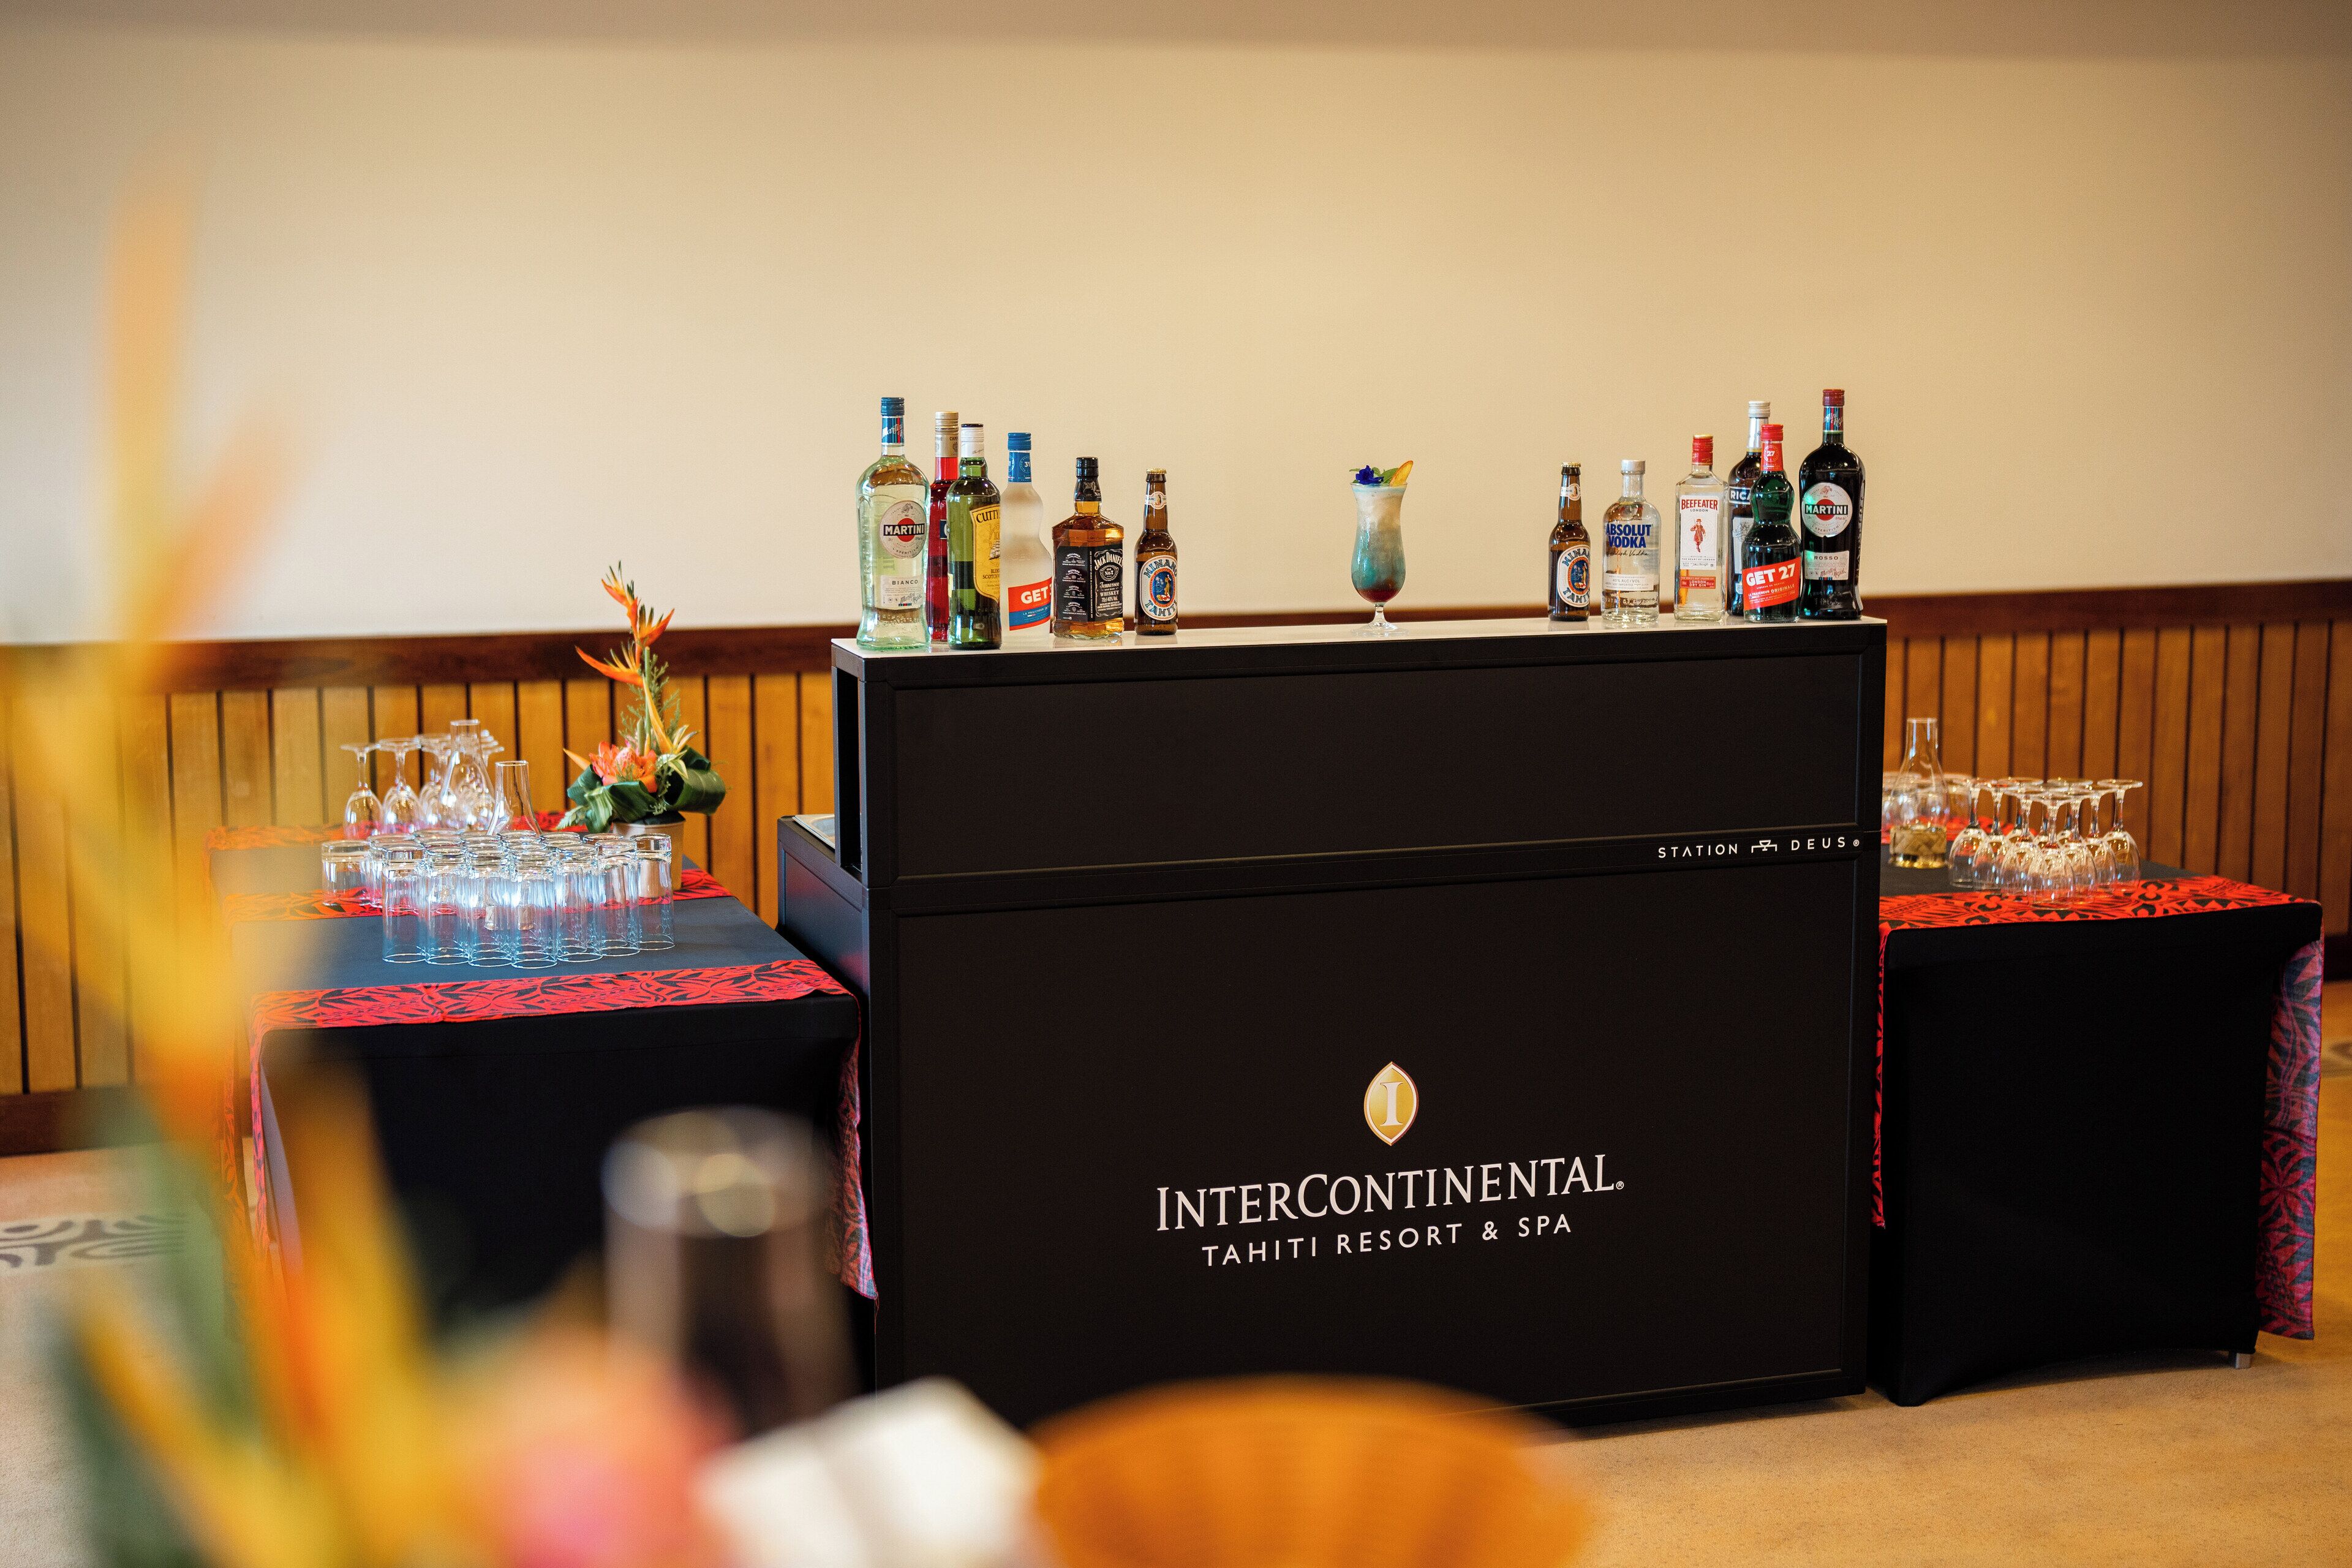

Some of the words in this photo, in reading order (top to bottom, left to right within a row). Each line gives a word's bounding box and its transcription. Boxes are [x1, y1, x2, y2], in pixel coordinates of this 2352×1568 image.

[1681, 499, 1718, 511] BEEFEATER
[1806, 505, 1847, 514] MARTINI
[885, 524, 924, 535] MARTINI
[1606, 524, 1652, 537] ABSOLUT
[1608, 536, 1646, 548] VODKA
[1094, 555, 1107, 570] JACK
[1746, 568, 1776, 586] GET
[1778, 563, 1795, 581] 27
[1021, 586, 1049, 605] GET
[1771, 584, 1795, 594] ORIGINALE
[1658, 843, 1738, 858] STATION
[1791, 837, 1845, 851] DEUS
[1202, 1237, 1317, 1267] TAHITI
[1337, 1223, 1463, 1254] RESORT
[1482, 1221, 1498, 1241] &
[1518, 1213, 1572, 1237] SPA
